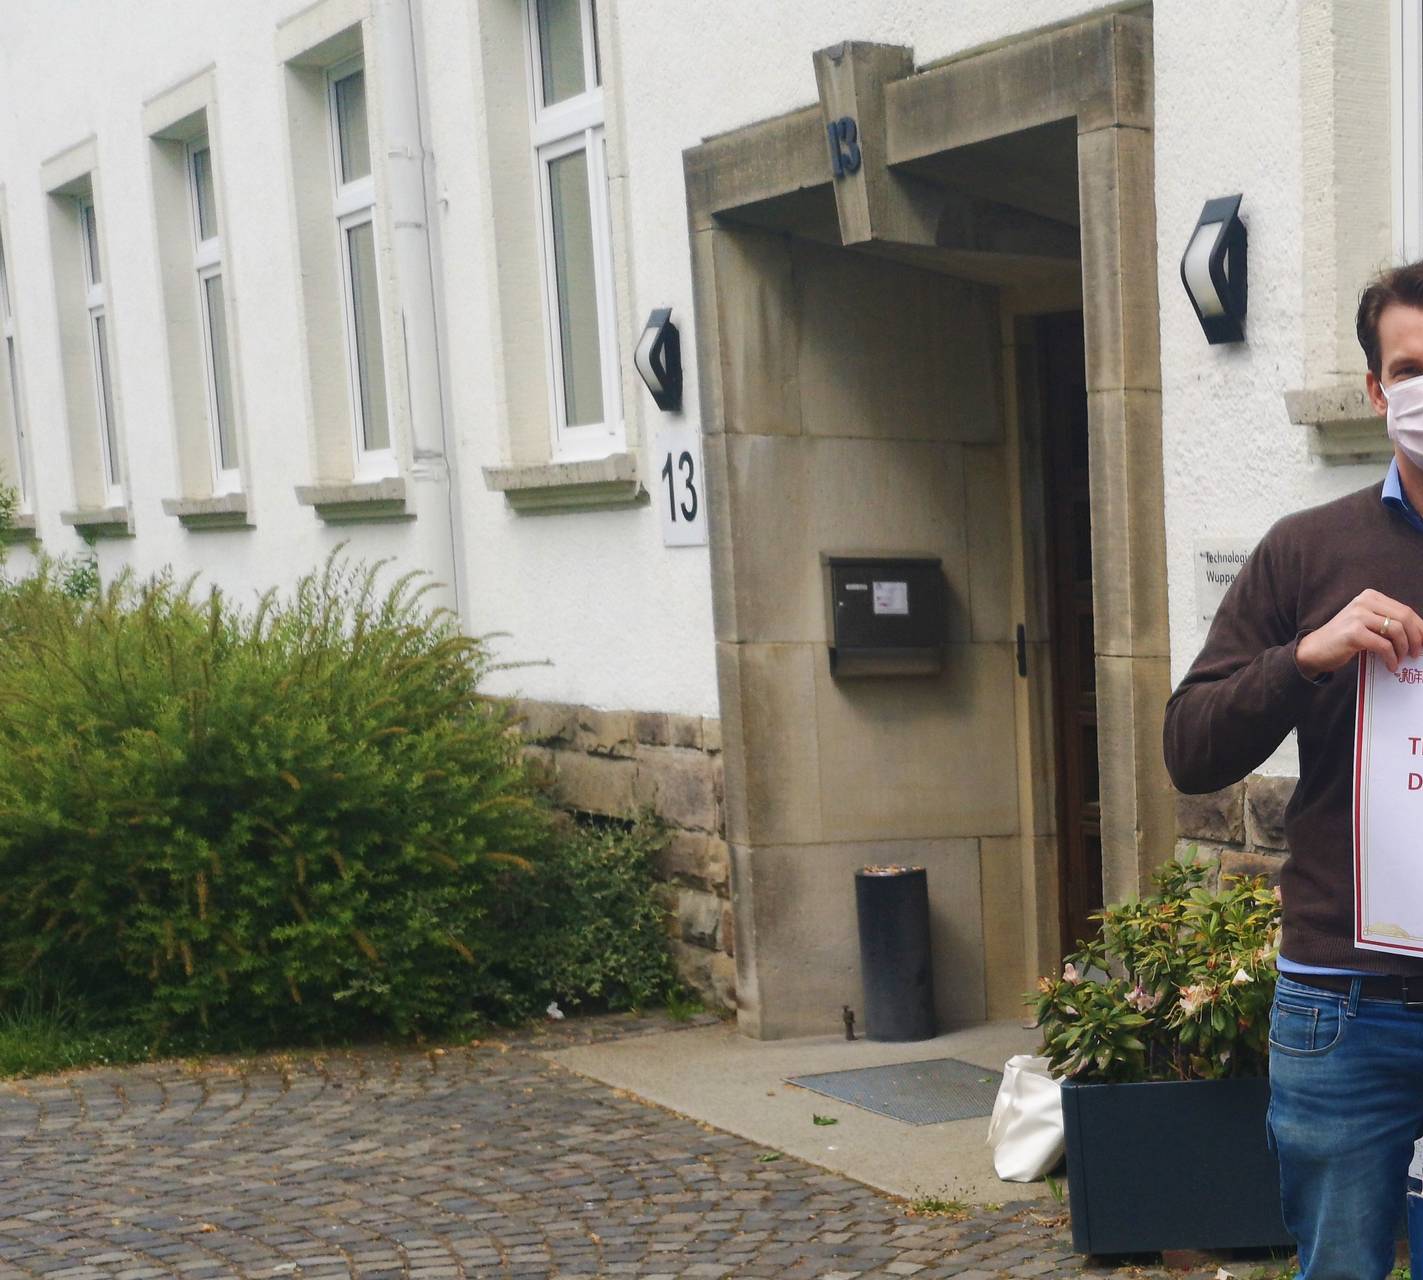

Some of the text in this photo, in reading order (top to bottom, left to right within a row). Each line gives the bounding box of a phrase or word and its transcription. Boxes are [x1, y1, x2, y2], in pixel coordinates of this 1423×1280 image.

[826, 116, 861, 178] 13
[661, 451, 698, 522] 13
[1205, 550, 1249, 565] Technologi
[1206, 571, 1239, 585] Wuppe
